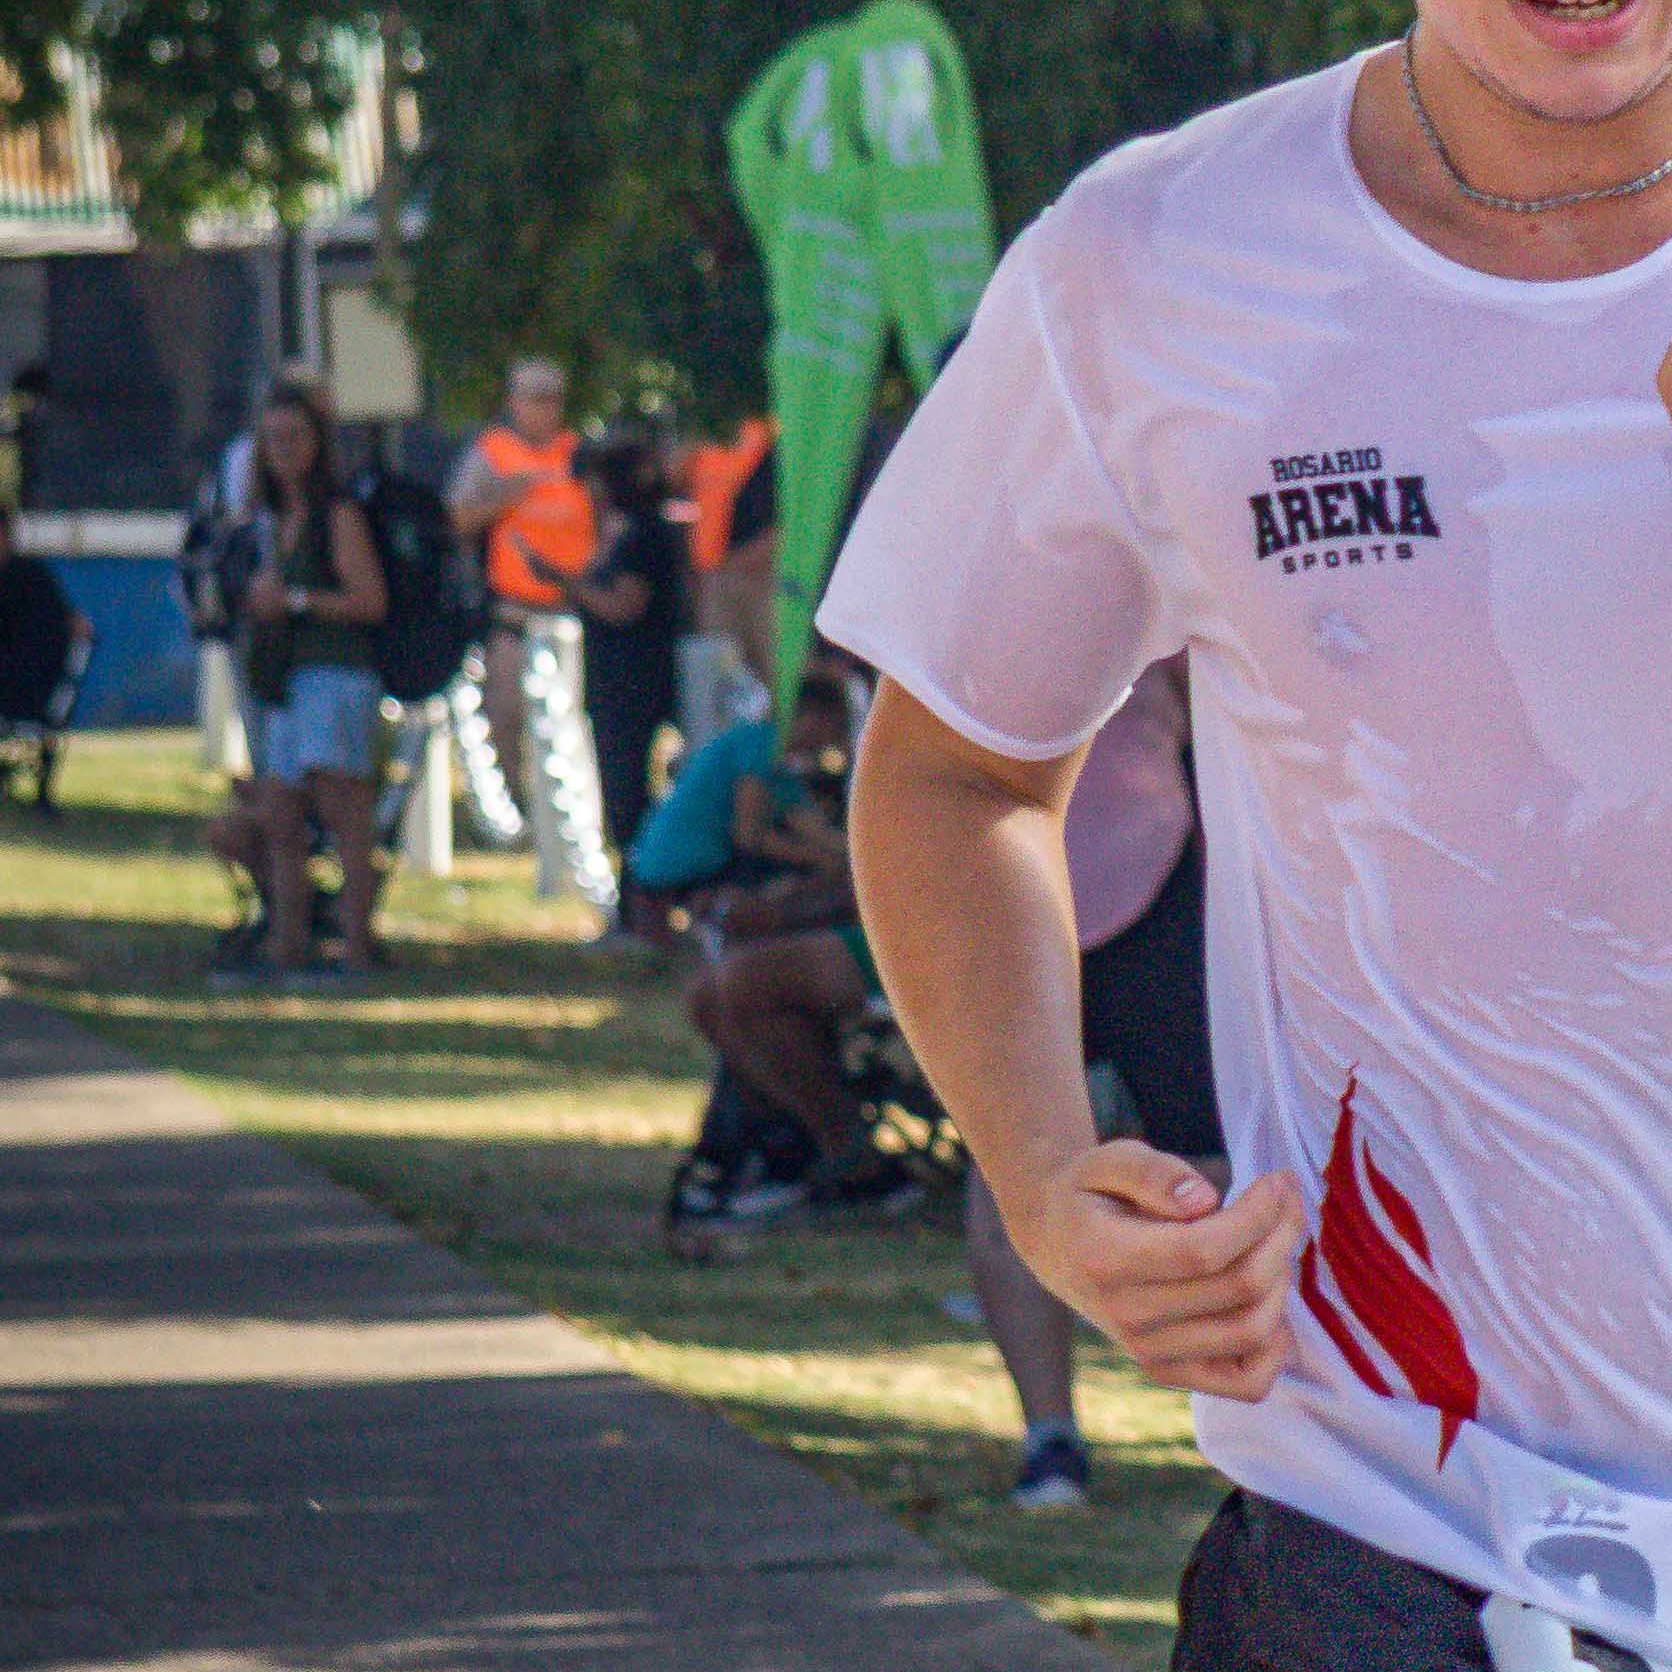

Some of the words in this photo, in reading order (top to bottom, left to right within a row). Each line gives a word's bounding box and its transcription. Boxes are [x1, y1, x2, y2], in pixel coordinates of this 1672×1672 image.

[1270, 446, 1382, 481] ROSARIO
[1249, 475, 1441, 560] ARENA
[1283, 542, 1413, 575] SPORTS
